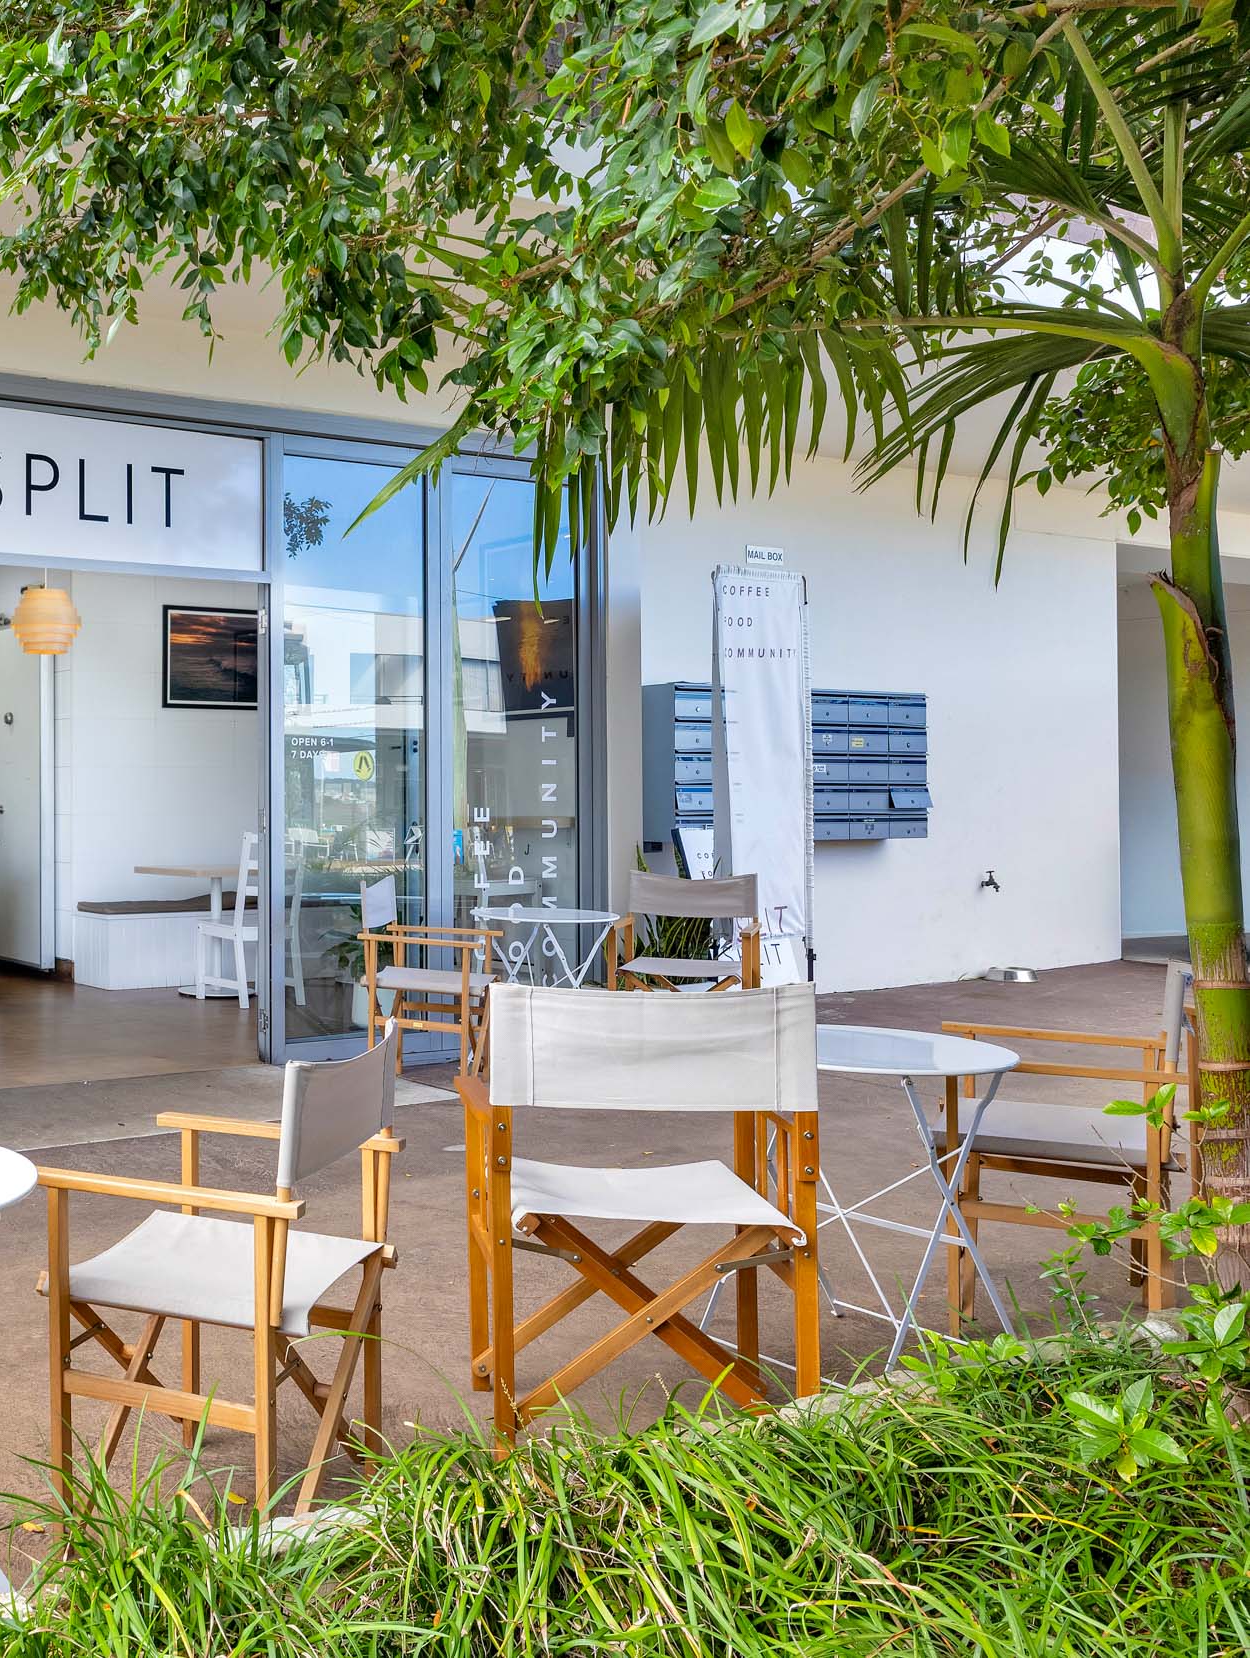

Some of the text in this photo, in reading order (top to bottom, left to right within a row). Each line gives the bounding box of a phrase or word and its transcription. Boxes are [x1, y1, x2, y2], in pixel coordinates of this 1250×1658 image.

[747, 550, 783, 562] MAIL BOX
[722, 585, 770, 597] COFFEE
[291, 737, 334, 747] OPEN 6-1
[291, 750, 297, 759] 7
